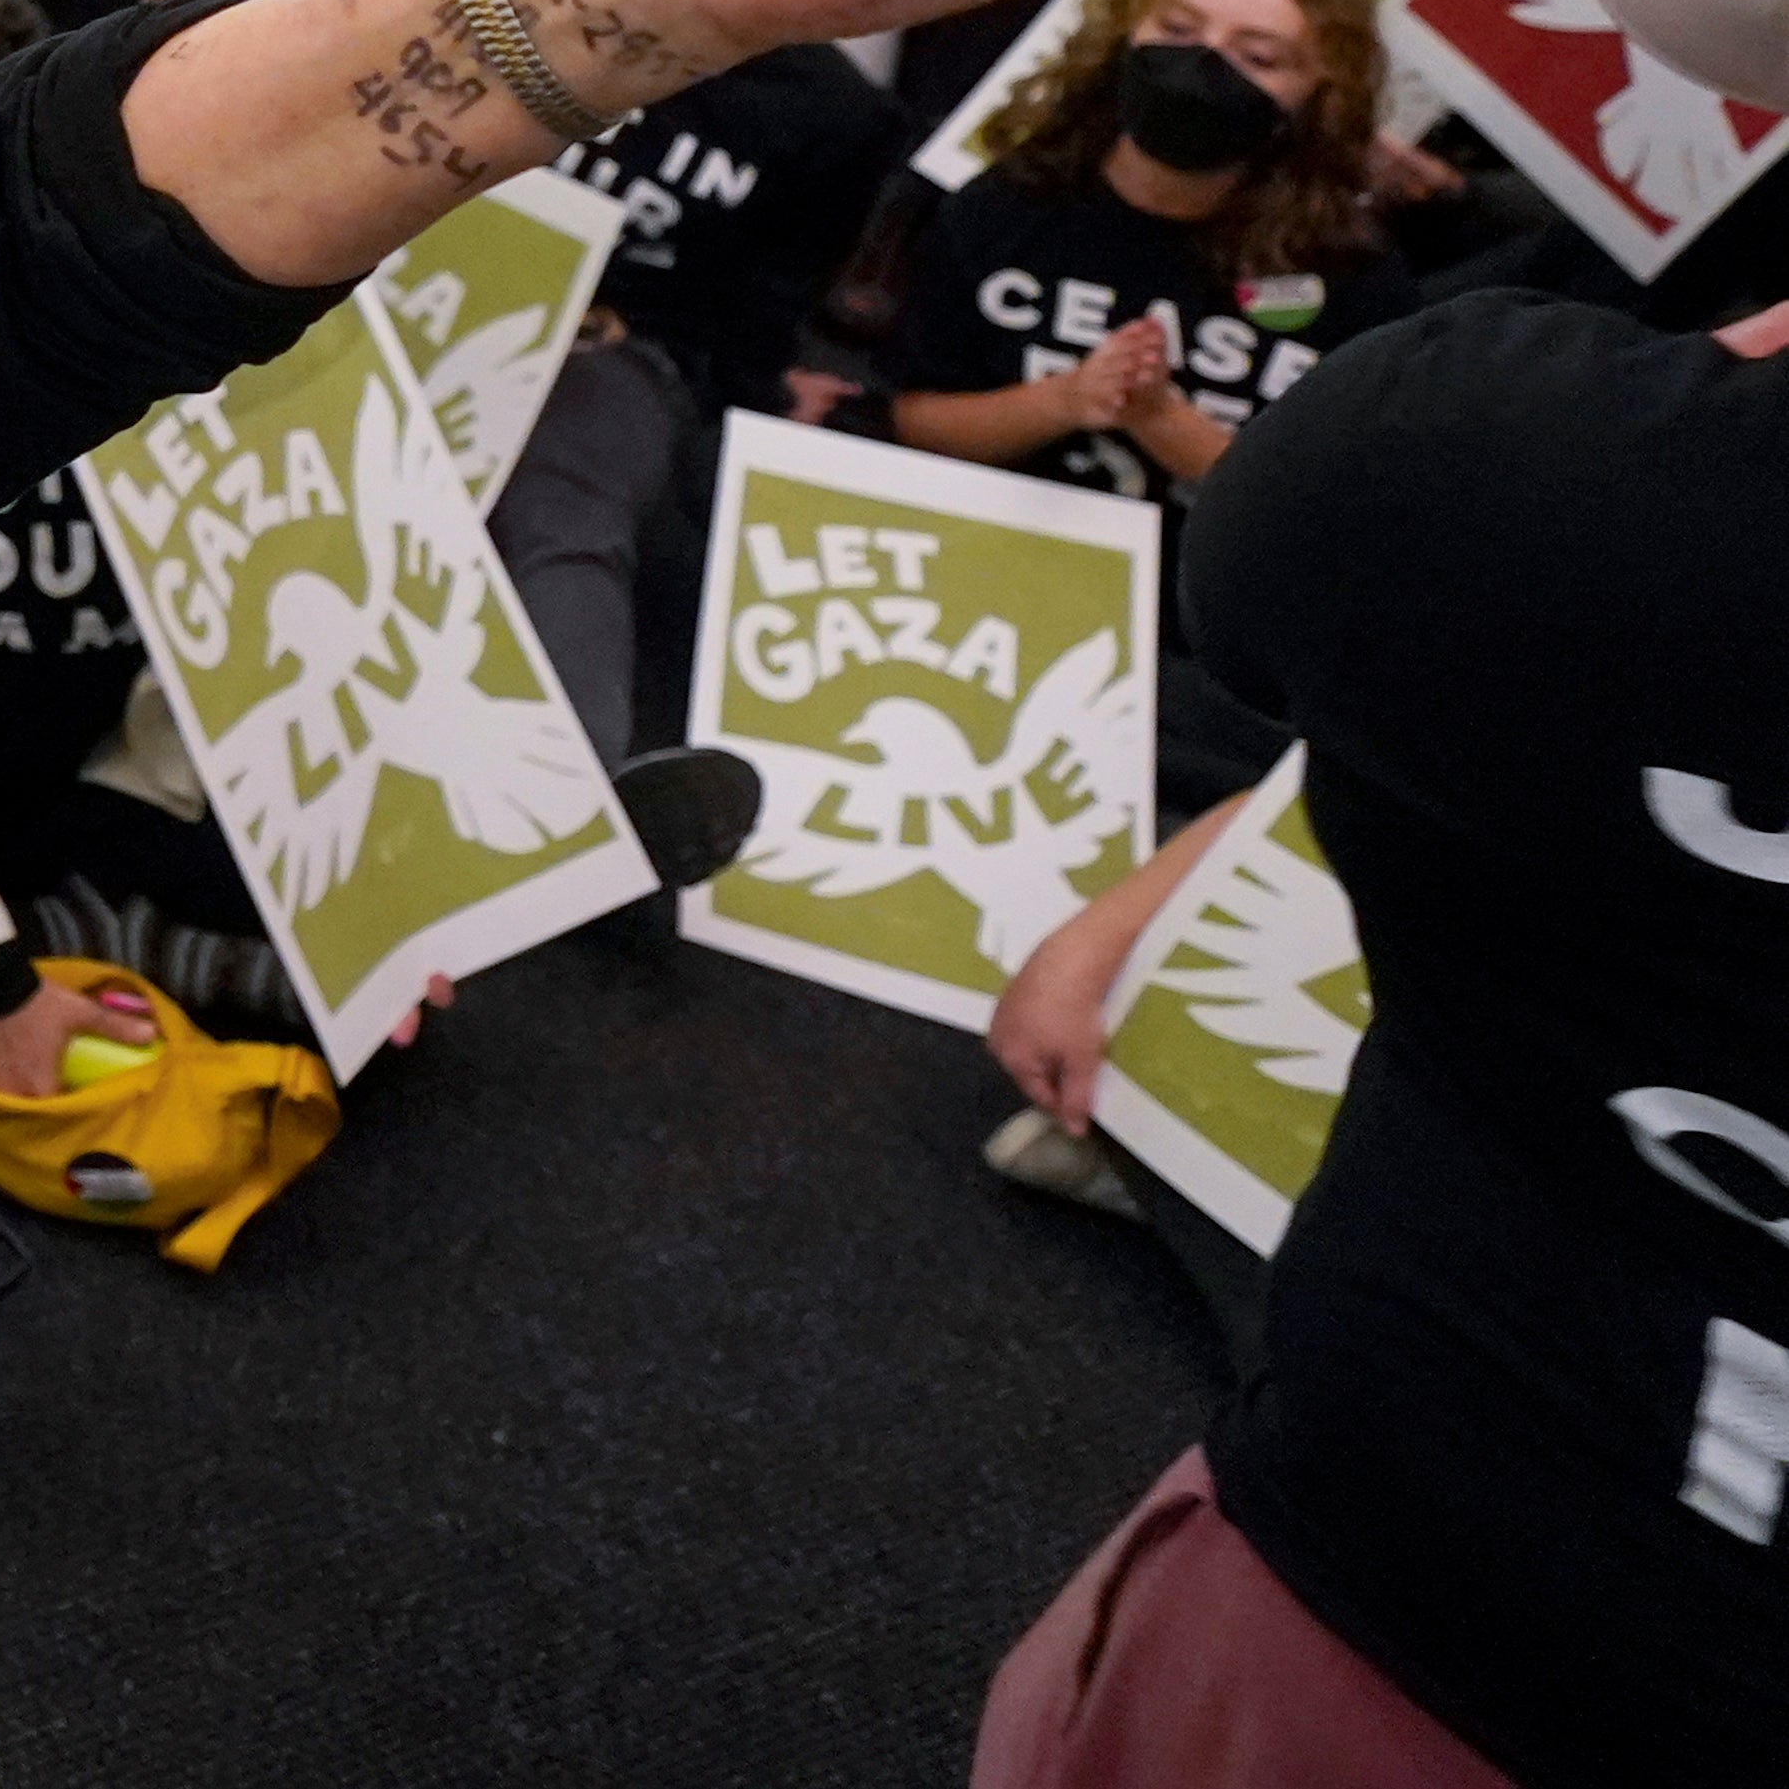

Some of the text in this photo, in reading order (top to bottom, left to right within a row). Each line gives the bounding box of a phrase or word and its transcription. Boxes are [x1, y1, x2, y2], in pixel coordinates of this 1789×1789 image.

[656, 130, 760, 190] IN
[110, 382, 237, 552] LET
[152, 427, 347, 670] GAZA
[746, 523, 940, 600] LET
[285, 522, 453, 808] LIVE
[731, 599, 1020, 704] GAZA
[803, 734, 1098, 847] LIVE
